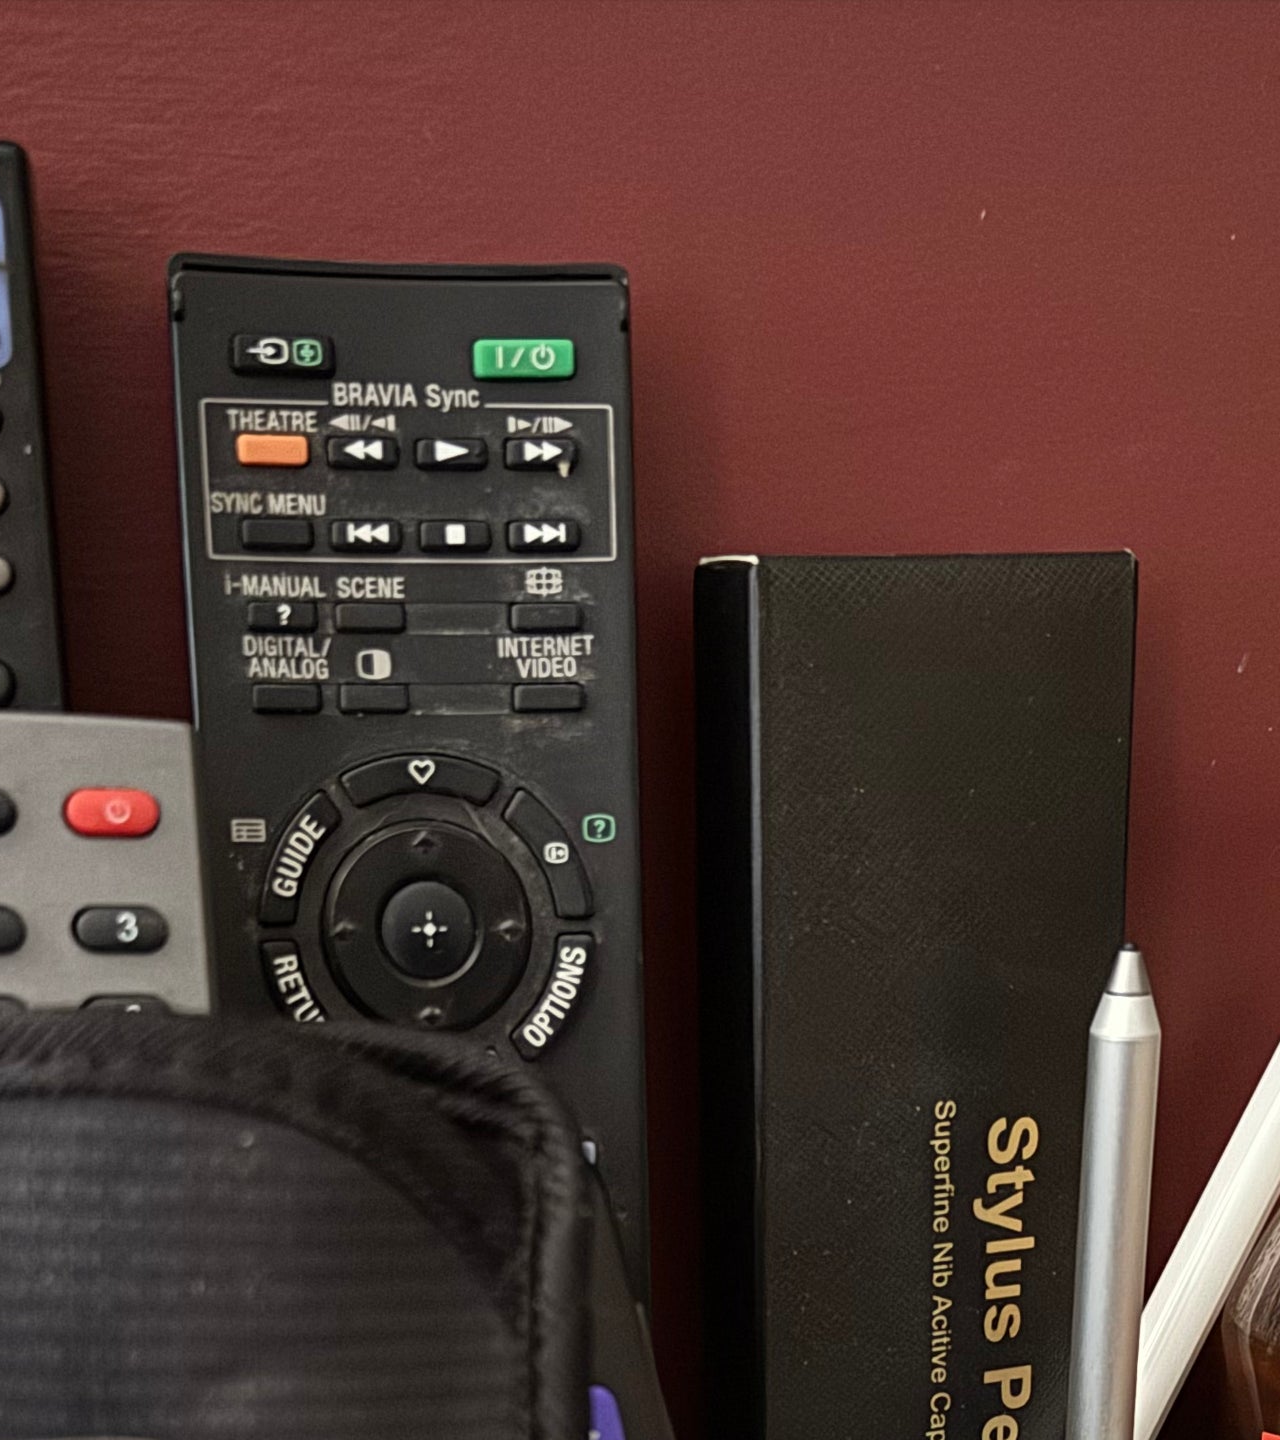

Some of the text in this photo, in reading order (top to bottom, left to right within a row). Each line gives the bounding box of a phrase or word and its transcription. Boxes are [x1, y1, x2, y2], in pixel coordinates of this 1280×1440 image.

[332, 381, 480, 412] BRAVIA Sync
[226, 409, 318, 433] THEATRE
[211, 491, 326, 515] SYNC MENU
[224, 574, 405, 599] i-MANUAL SCENE
[243, 636, 332, 657] DIGITAL/
[497, 635, 594, 657] INTERNET
[248, 658, 330, 679] ANALOG
[517, 657, 577, 678] VIDEO
[272, 813, 326, 898] GUIDE
[116, 911, 139, 942] 3
[273, 952, 325, 1022] RETU
[522, 945, 588, 1048] OPTIONS
[929, 1099, 956, 1234] Superfine
[973, 1115, 1039, 1343] Stylus
[932, 1242, 954, 1288] Nib
[930, 1294, 954, 1384] Acitive
